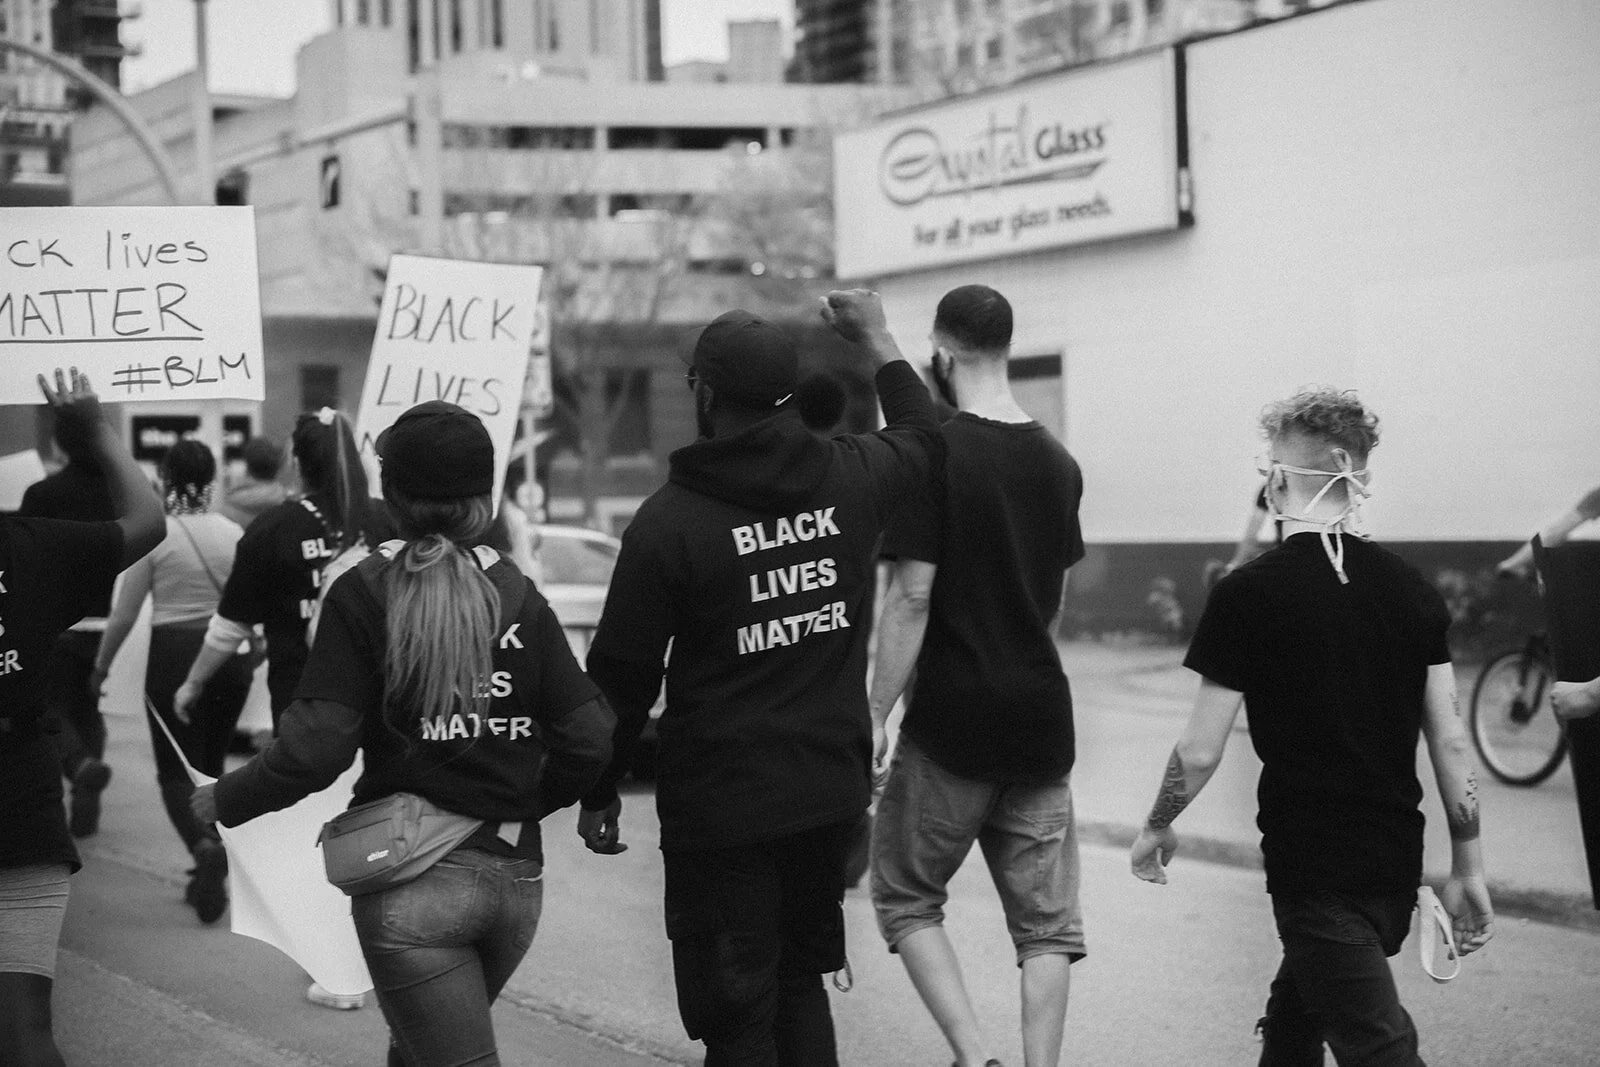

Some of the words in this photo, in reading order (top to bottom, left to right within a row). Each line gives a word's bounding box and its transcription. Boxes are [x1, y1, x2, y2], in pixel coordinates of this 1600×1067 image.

[1035, 121, 1107, 160] Glass
[387, 283, 517, 344] BLACK
[111, 352, 251, 394] #BLM
[377, 364, 504, 417] LIVES
[731, 506, 841, 556] BLACK
[749, 557, 838, 603] LIVES
[736, 600, 851, 655] MATTER
[419, 712, 533, 742] MATER
